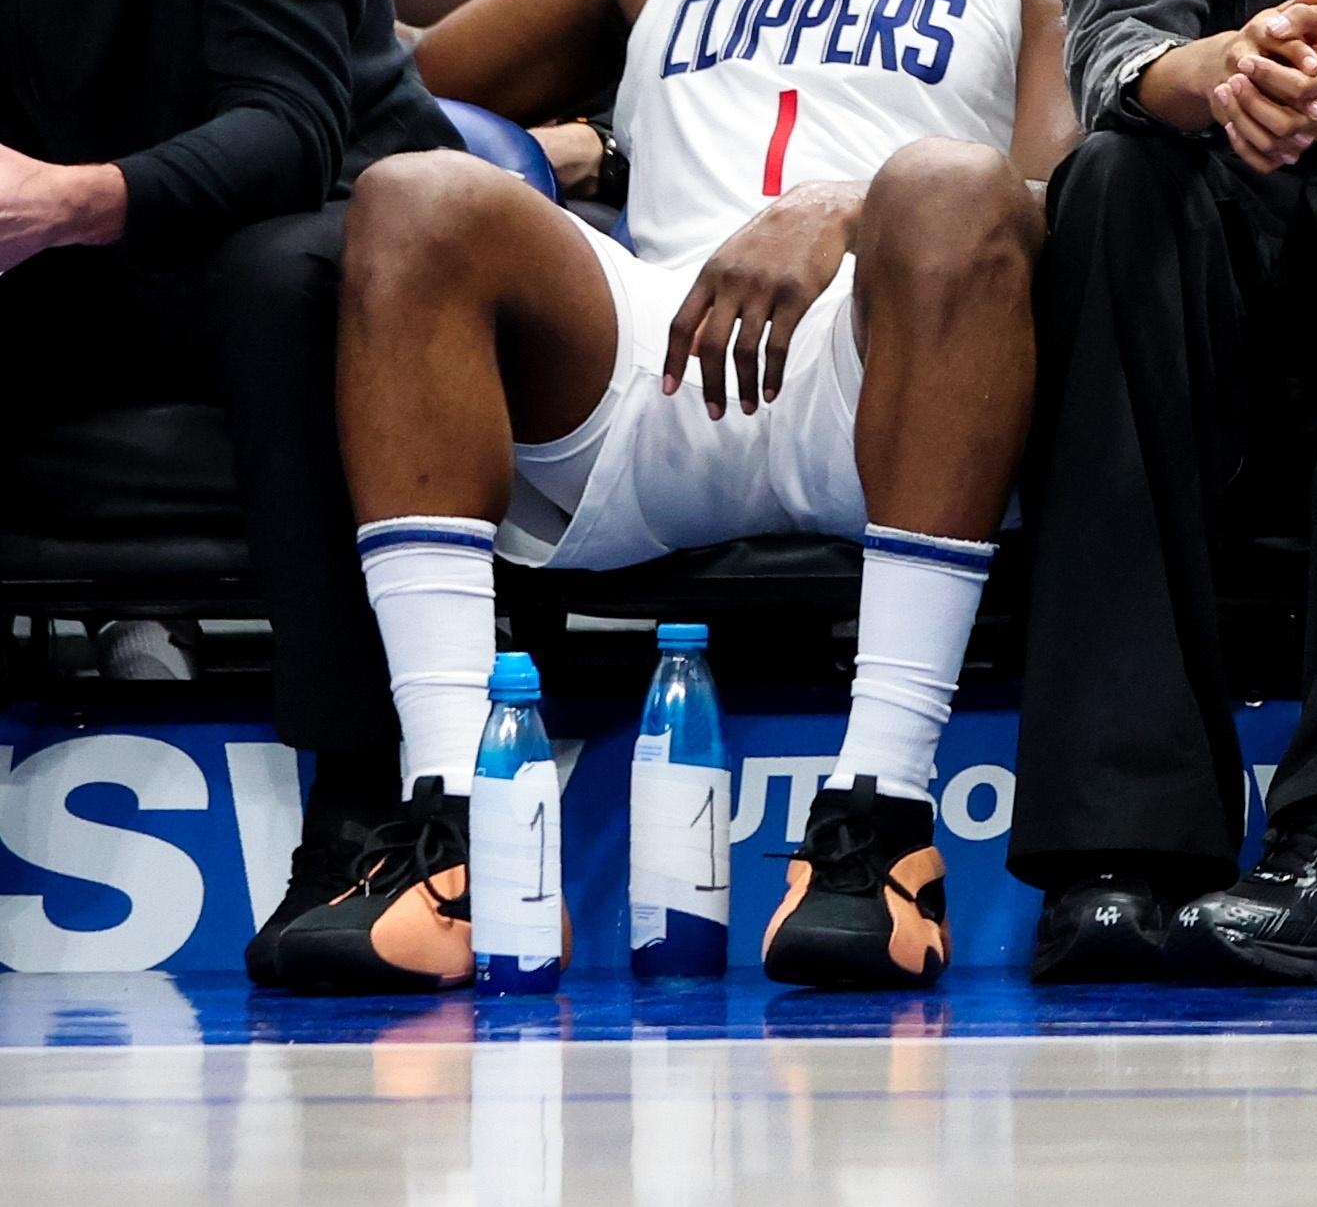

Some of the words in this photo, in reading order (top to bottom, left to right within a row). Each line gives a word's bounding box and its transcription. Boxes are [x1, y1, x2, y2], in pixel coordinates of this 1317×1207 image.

[762, 90, 797, 196] 1
[521, 801, 556, 902] 1
[690, 785, 730, 891] 1
